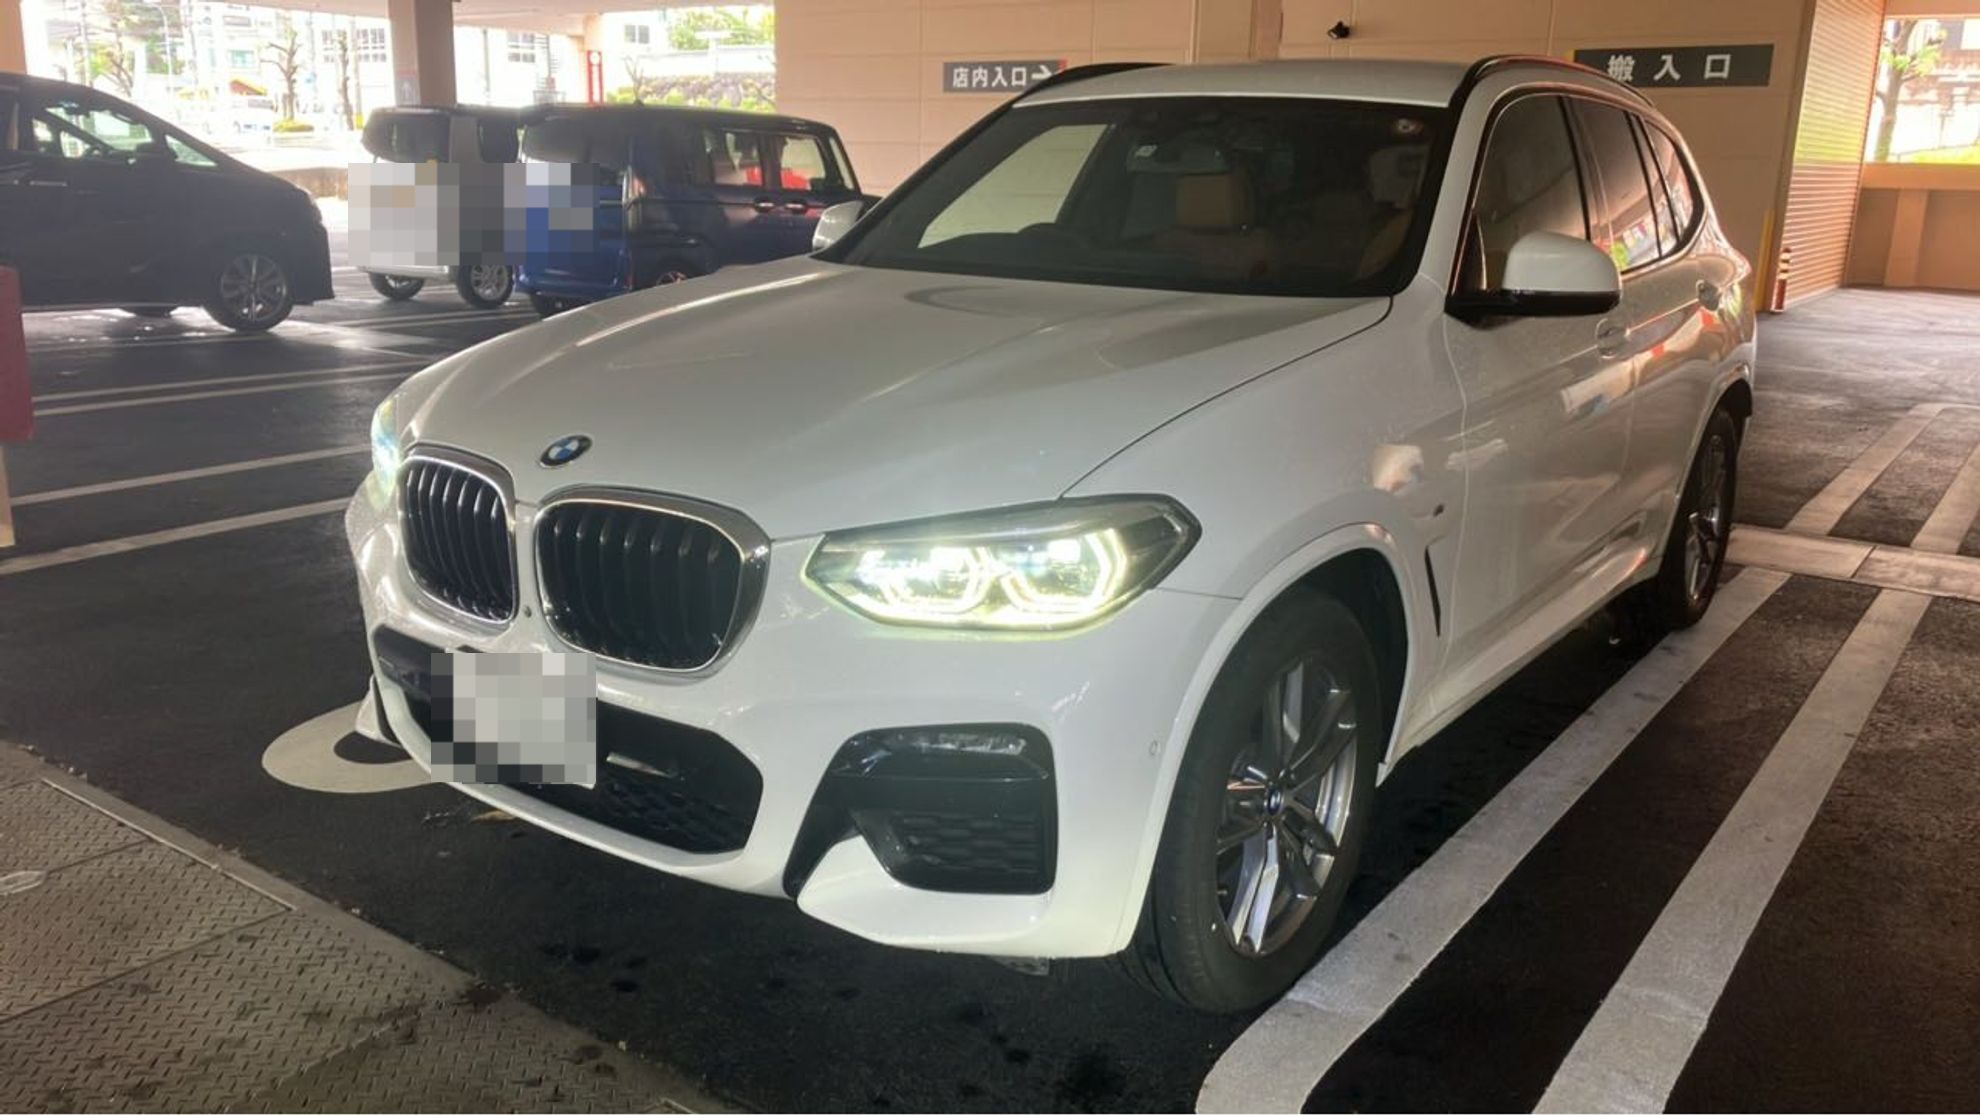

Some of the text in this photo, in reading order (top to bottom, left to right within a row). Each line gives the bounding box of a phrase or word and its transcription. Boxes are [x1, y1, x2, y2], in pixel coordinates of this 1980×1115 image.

[953, 66, 1027, 88] 店内入口
[1608, 54, 1731, 82] 搬入口
